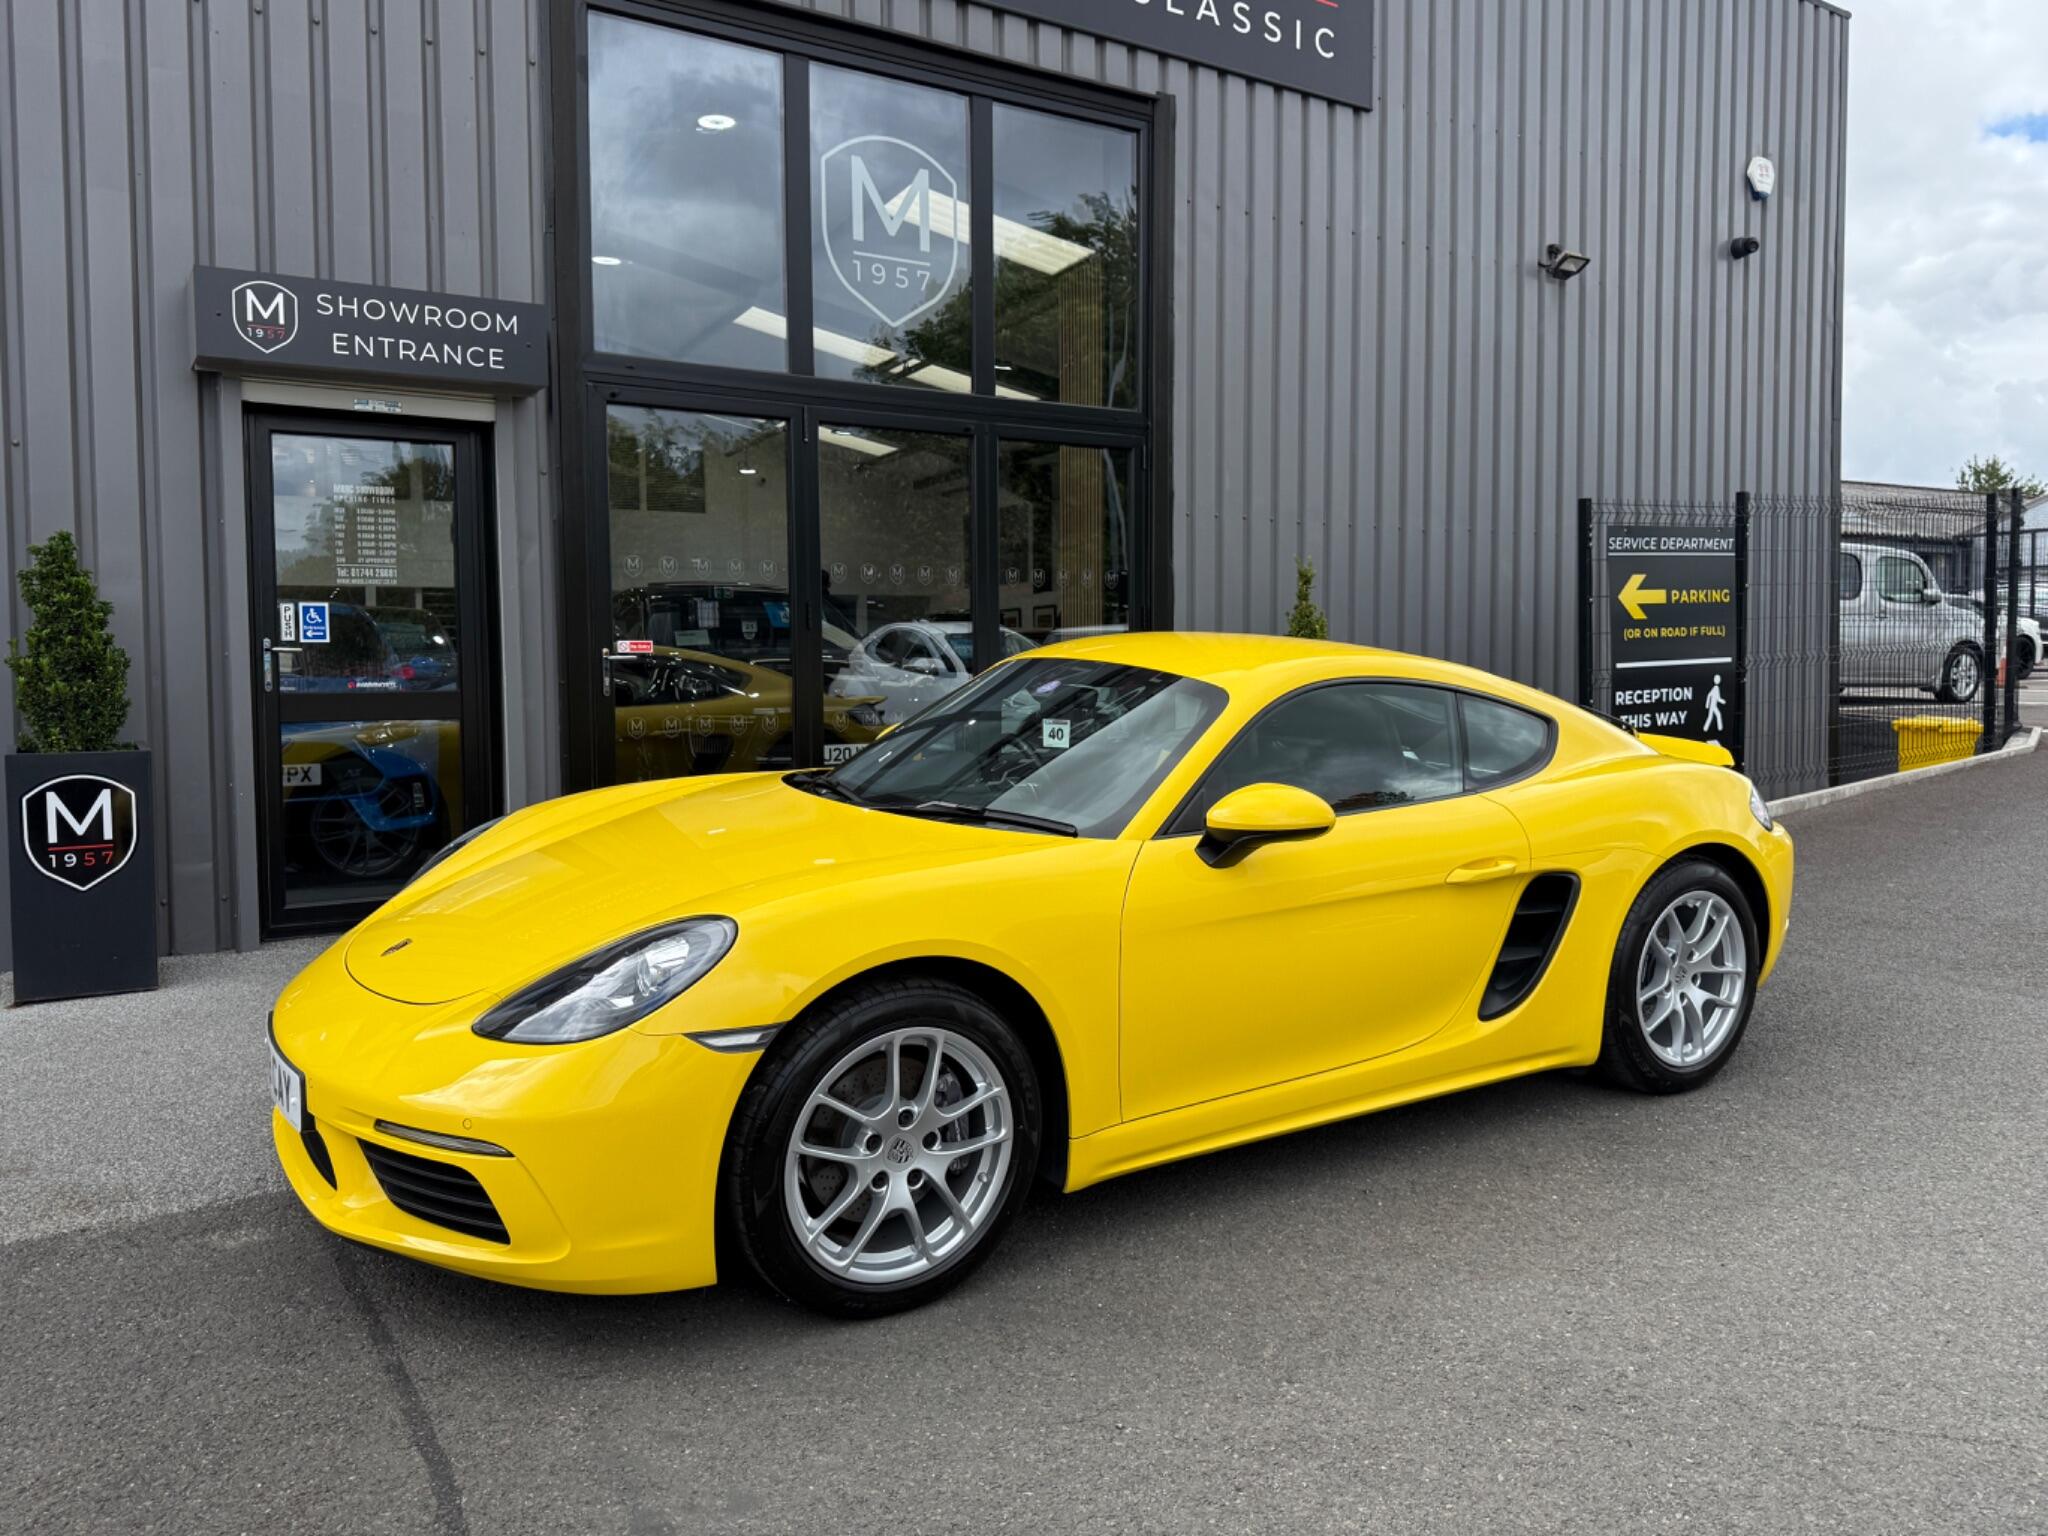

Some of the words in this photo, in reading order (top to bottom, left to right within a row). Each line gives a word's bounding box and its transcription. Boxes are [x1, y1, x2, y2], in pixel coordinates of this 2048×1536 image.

[1135, 0, 1335, 59] LASSIC
[851, 155, 930, 253] M
[852, 260, 930, 292] 1957
[246, 288, 285, 325] M
[316, 293, 518, 335] SHOWROOM
[247, 327, 286, 340] 1957
[332, 332, 505, 369] ENTRANCE
[1608, 537, 1658, 550] SERVICE
[1660, 538, 1735, 550] DEPARTMENT
[1671, 589, 1730, 604] PARKING
[284, 606, 293, 639] PUSH
[1623, 627, 1641, 641] (OR
[1643, 627, 1658, 638] ON
[1661, 626, 1687, 638] ROAD
[1690, 626, 1699, 637] IF
[1700, 625, 1726, 637] FULL)
[1615, 687, 1693, 705] RECEPTION
[1620, 713, 1651, 729] THIS
[1656, 711, 1688, 726] WAY
[1048, 727, 1064, 741] 40
[46, 788, 113, 844] M
[48, 851, 114, 868] 1957
